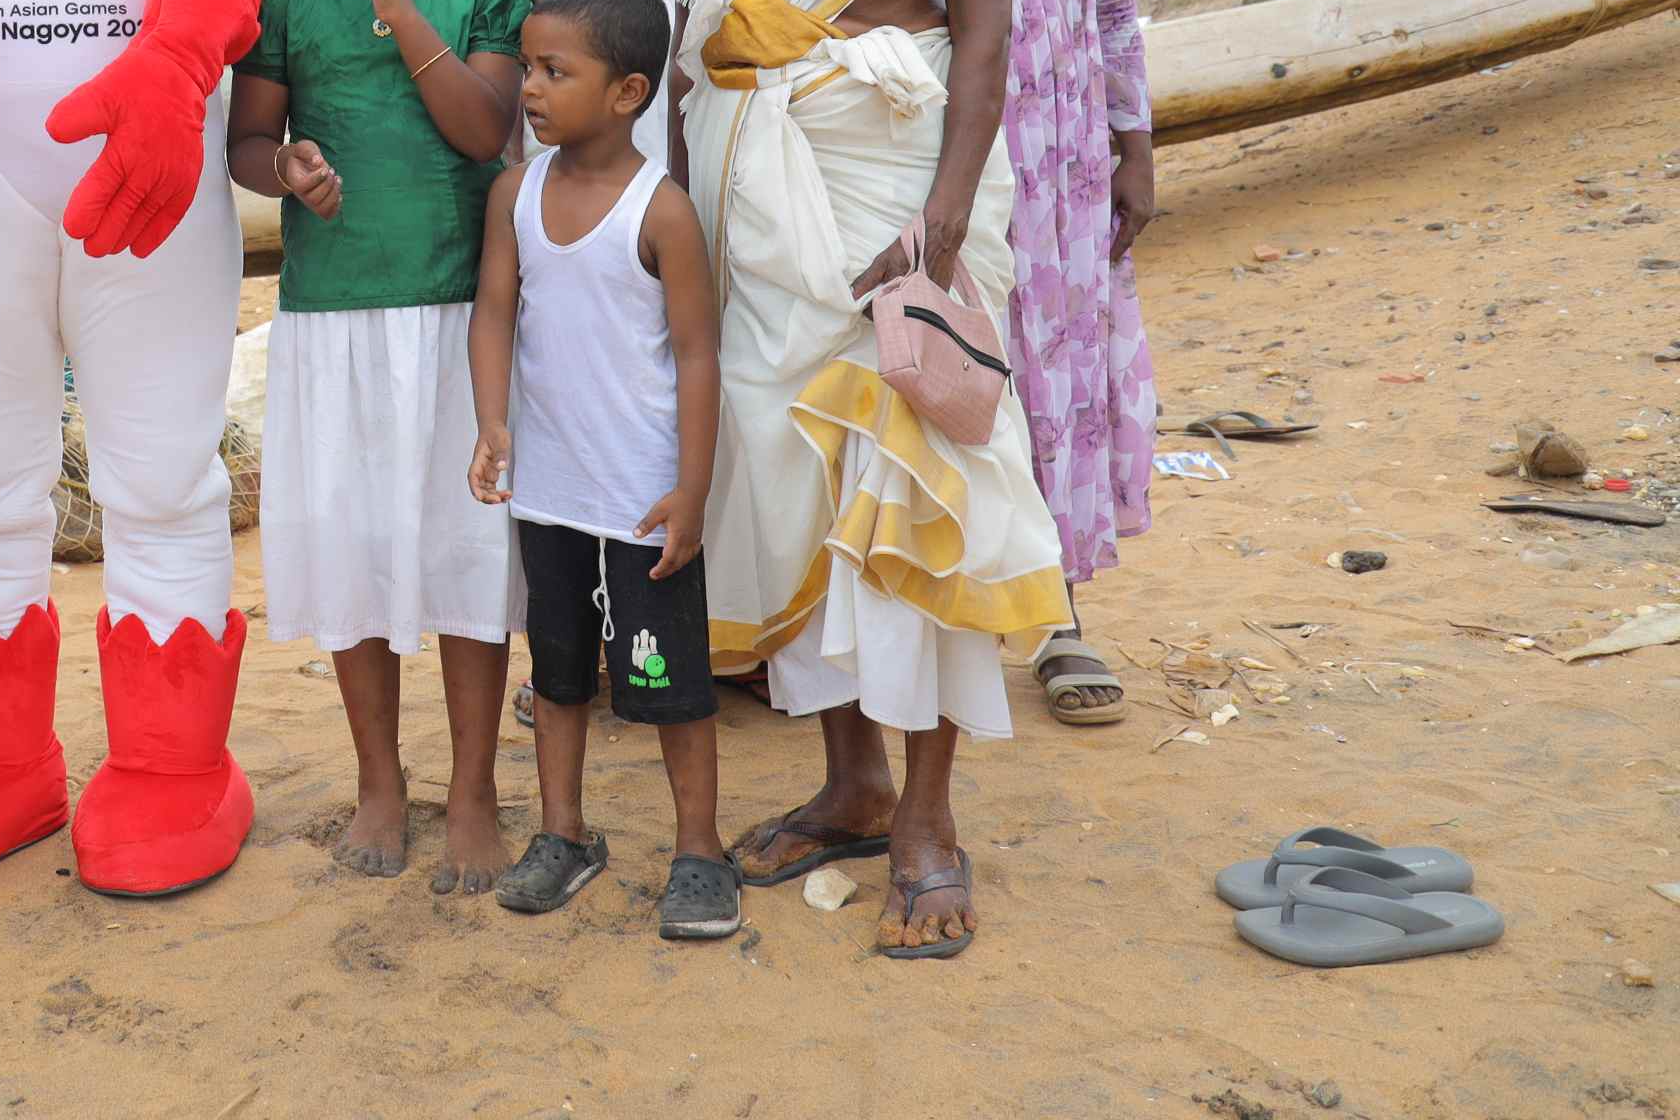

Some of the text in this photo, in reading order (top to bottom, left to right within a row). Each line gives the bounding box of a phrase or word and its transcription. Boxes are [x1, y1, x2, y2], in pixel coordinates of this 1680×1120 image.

[10, 2, 59, 17] Asian
[64, 2, 128, 15] Games
[106, 18, 143, 38] 20
